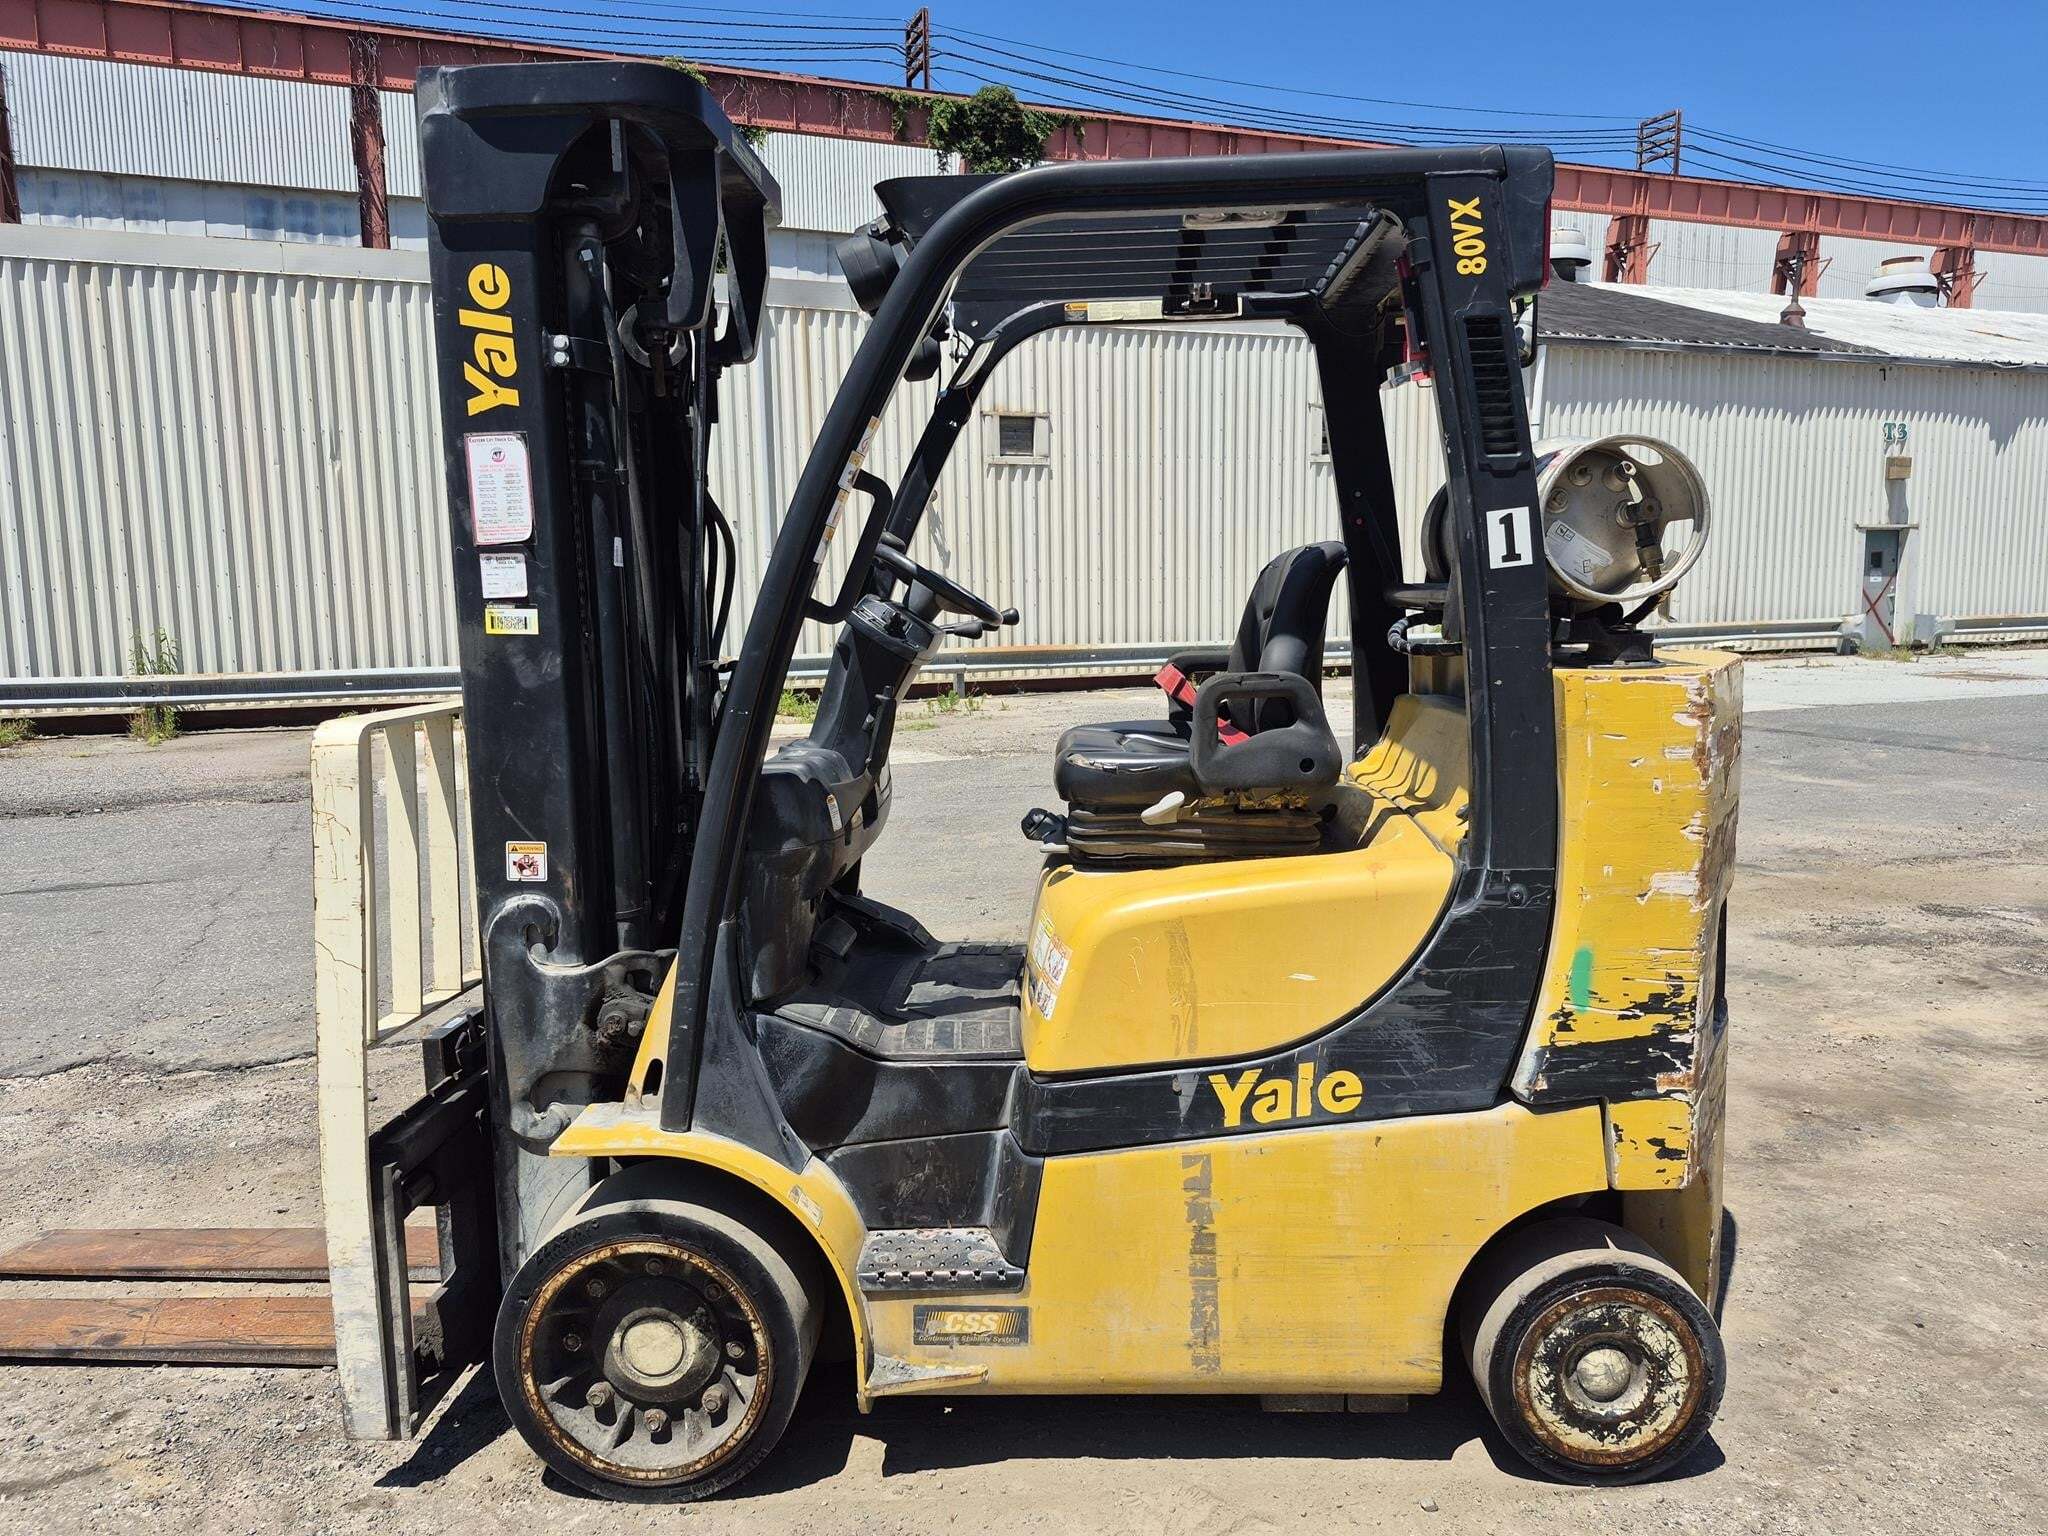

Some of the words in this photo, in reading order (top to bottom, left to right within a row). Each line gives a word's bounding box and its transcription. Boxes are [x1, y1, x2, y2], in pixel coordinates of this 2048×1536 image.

[1447, 196, 1487, 275] 80VX
[459, 262, 520, 417] Yale
[1884, 422, 1908, 440] T3
[1498, 512, 1522, 563] 1
[1208, 1062, 1363, 1128] Yale
[945, 1313, 999, 1332] CSS
